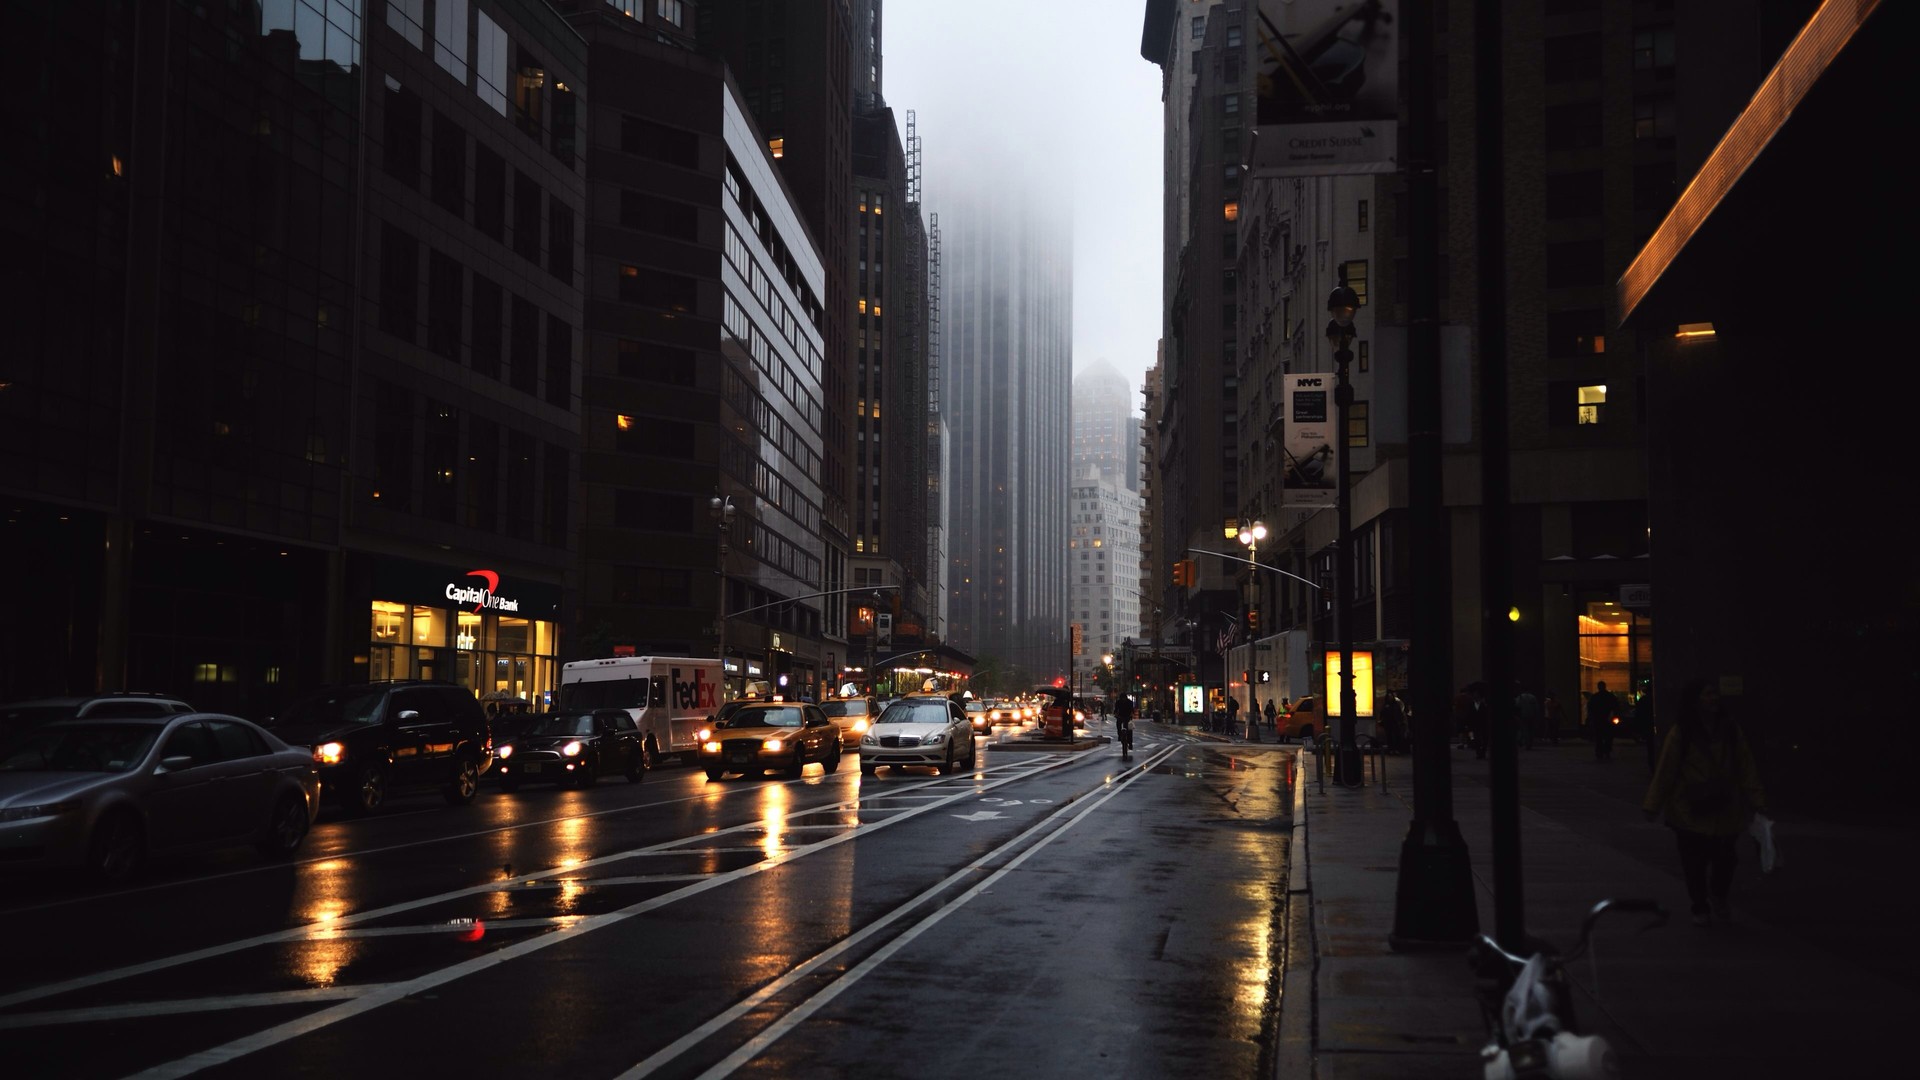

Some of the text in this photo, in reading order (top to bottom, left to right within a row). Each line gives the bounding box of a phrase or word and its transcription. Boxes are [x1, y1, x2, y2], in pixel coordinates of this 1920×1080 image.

[1289, 136, 1364, 149] CREDIT SUISSE
[1297, 378, 1322, 387] NYC
[499, 597, 519, 612] Bank
[671, 668, 717, 710] FedEx
